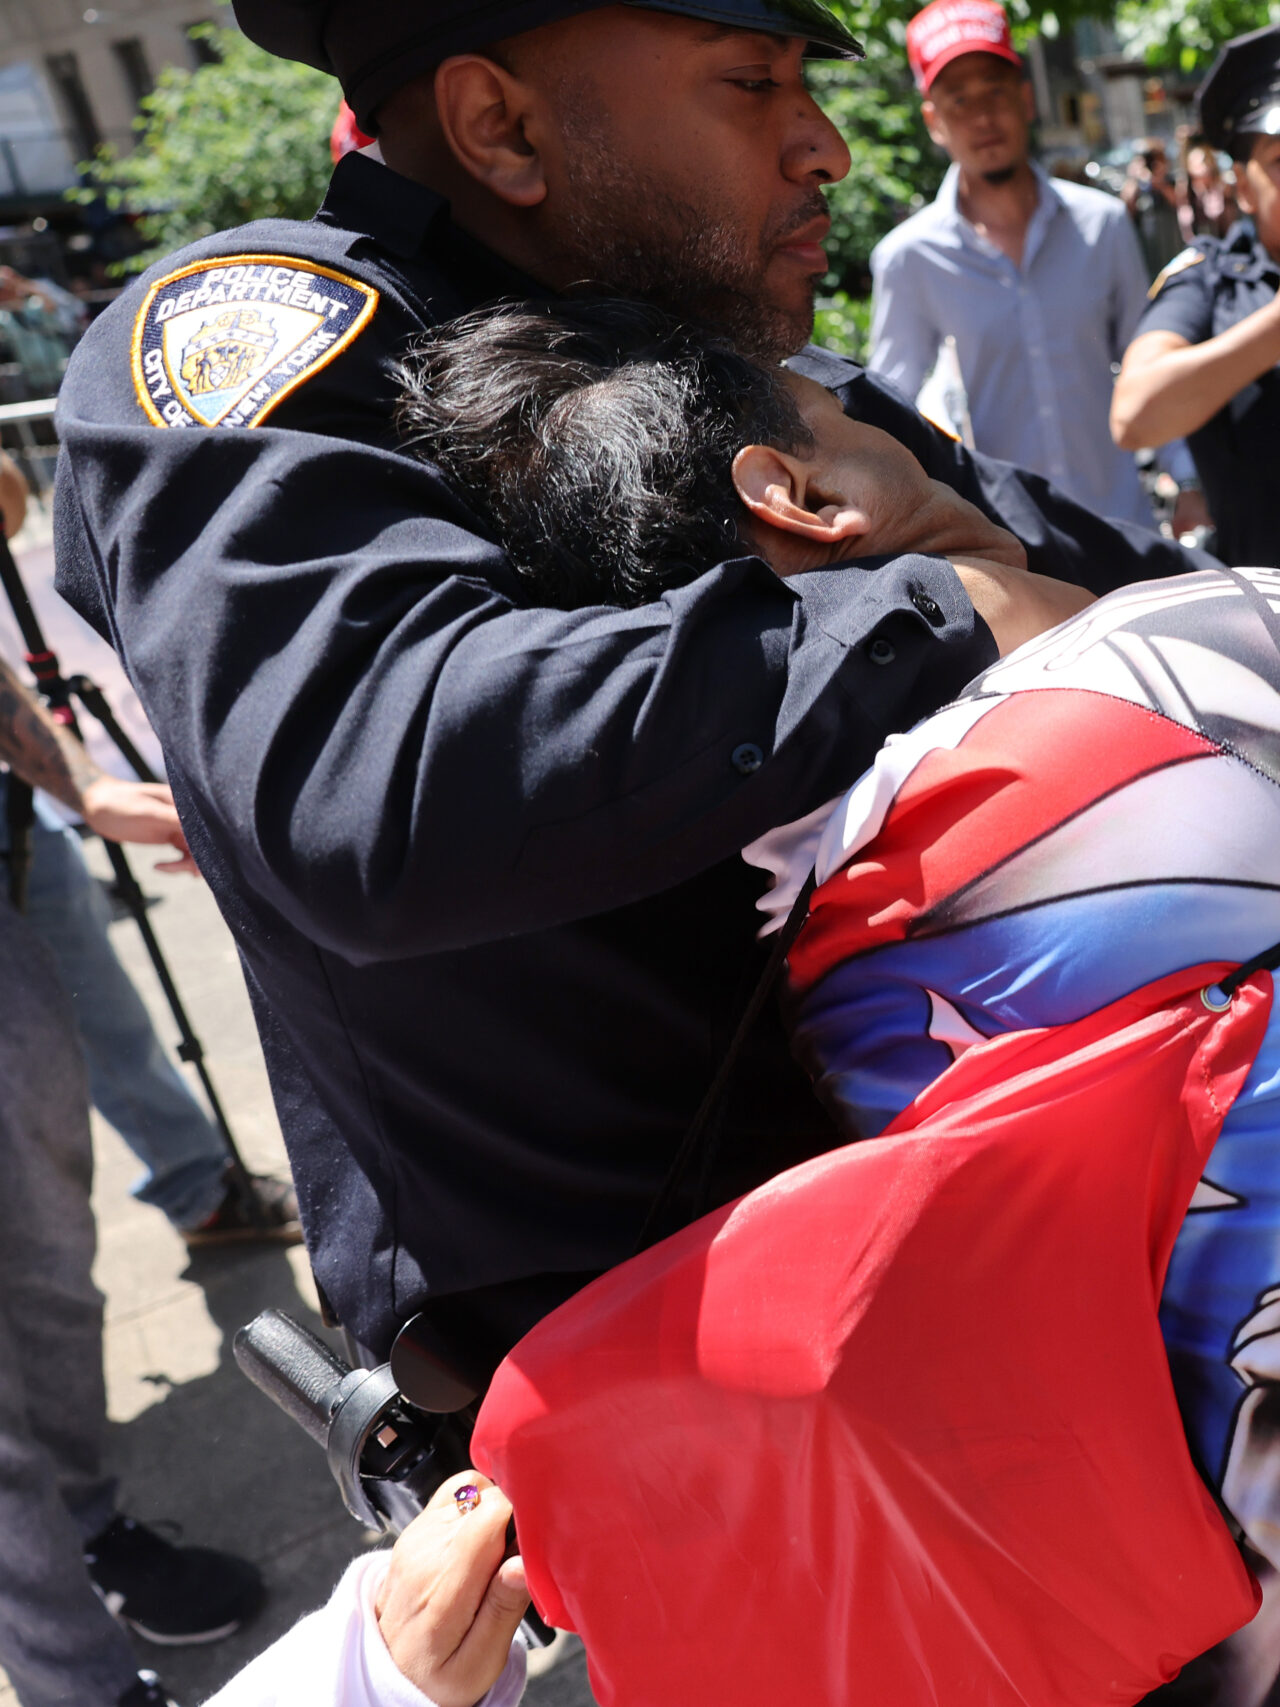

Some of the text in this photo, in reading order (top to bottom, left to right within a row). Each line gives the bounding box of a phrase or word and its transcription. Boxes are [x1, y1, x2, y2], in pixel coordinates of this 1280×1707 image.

[203, 266, 315, 290] POLICE
[155, 282, 348, 323] DEPARTMENT
[145, 330, 336, 428] CITY OF NEW YORK
